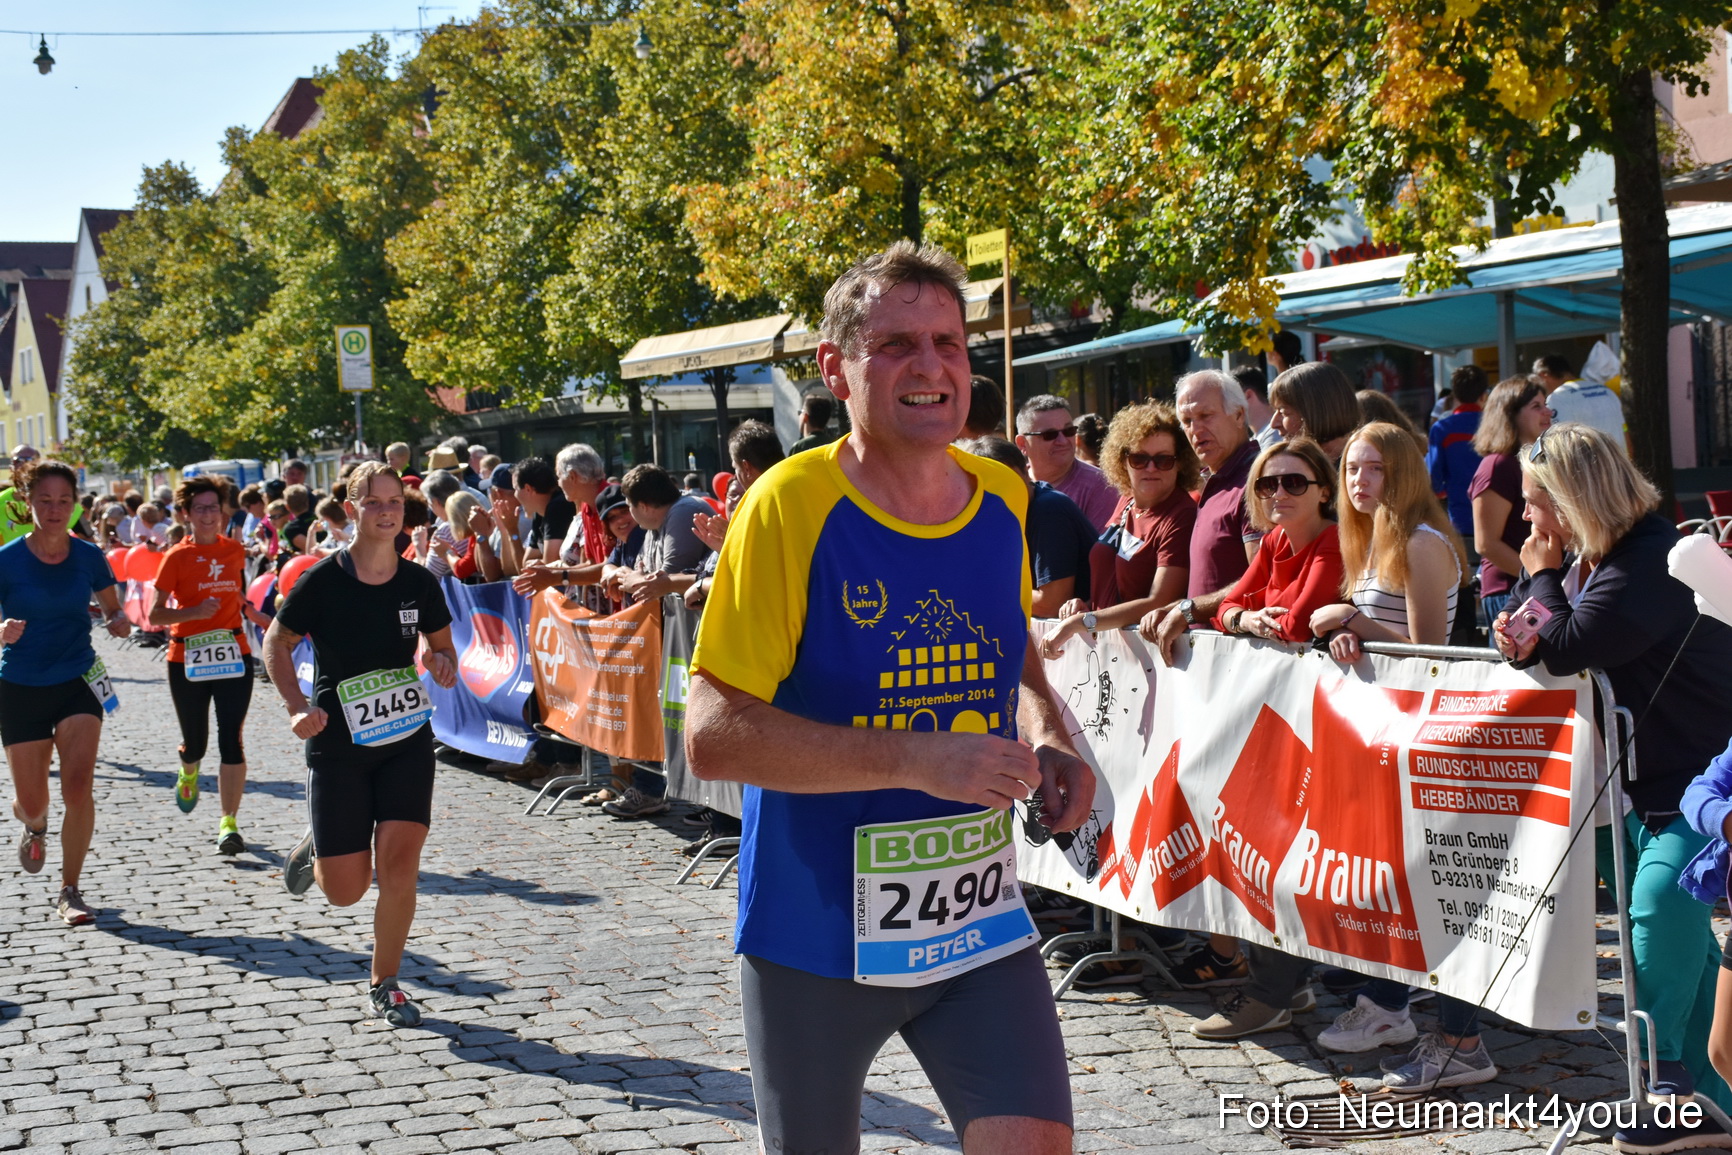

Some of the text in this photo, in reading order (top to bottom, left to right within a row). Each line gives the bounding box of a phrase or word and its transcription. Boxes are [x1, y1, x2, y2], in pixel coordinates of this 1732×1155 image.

[974, 241, 1004, 256] Toiletten
[857, 585, 869, 594] 15
[852, 599, 879, 609] Jahre
[403, 611, 416, 622] BRL
[191, 634, 230, 648] BOCK
[608, 633, 645, 648] Umsetzung
[192, 646, 236, 664] 2161
[194, 665, 236, 676] BRIGITTE
[347, 670, 408, 696] BOCK
[354, 688, 421, 726] 2449
[879, 688, 996, 709] 21.September 2014
[360, 713, 427, 740] MARIE-CLAIRE
[1421, 725, 1547, 746] VERZURRSYSTEME
[1380, 741, 1391, 766] Seit
[1416, 756, 1539, 779] RUNDSCHLINGEN
[1296, 767, 1312, 807] Seit 1929
[1419, 788, 1520, 811] HEBEBÄNDER
[875, 814, 1003, 863] BOCK
[1210, 798, 1271, 896] Braun
[1425, 828, 1509, 850] Braun GmbH
[1147, 822, 1200, 881] Braun
[1429, 849, 1519, 877] Am Grünberg 8
[1169, 863, 1188, 881] Sicher
[1296, 829, 1402, 915] Braun
[1431, 869, 1484, 889] D-92318
[880, 861, 1003, 930] 2490
[1247, 886, 1256, 899] ist
[1437, 898, 1462, 916] Tel.
[1464, 901, 1494, 922] 09181
[1501, 909, 1526, 933] 2307-0
[1335, 913, 1420, 942] Sicher ist sicher
[1442, 919, 1465, 937] Fax
[1468, 922, 1493, 944] 09181
[908, 928, 986, 968] PETER
